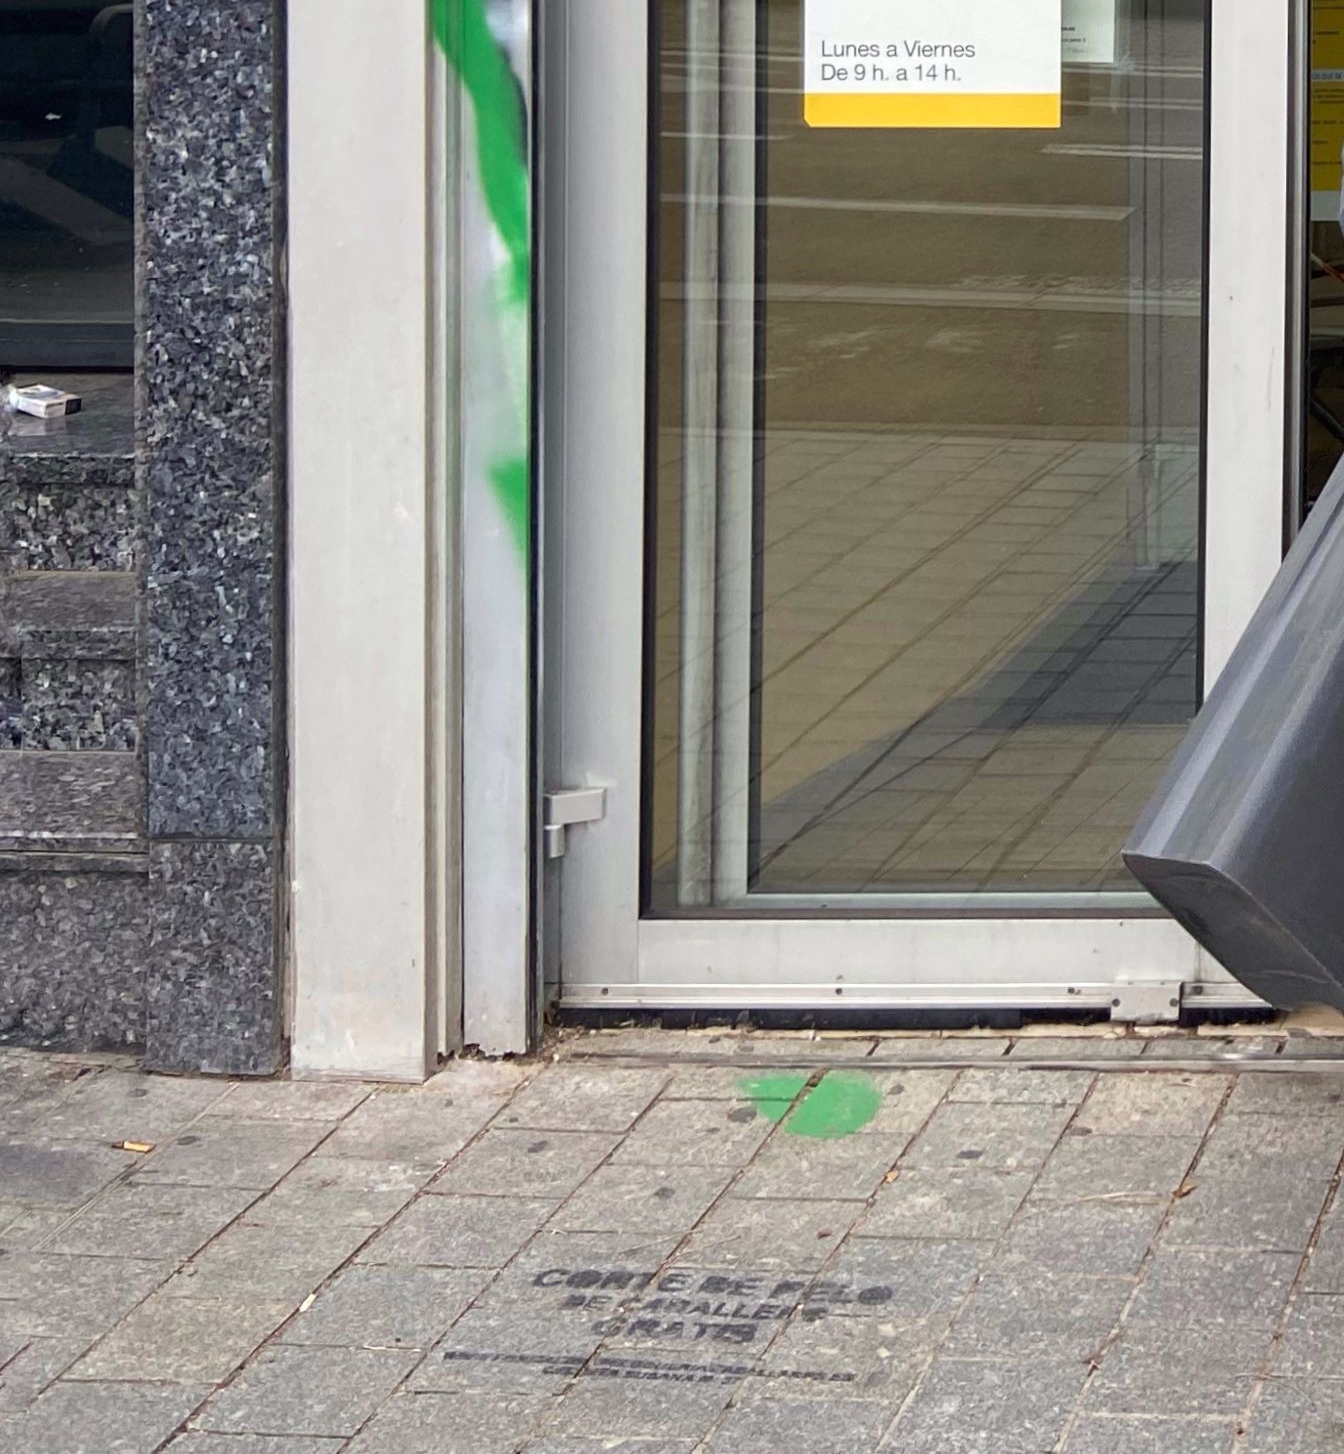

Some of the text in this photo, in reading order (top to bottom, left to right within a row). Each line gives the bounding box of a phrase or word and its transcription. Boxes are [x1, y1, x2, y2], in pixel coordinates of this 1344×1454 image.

[821, 39, 975, 57] Lunes a Viernes
[821, 63, 961, 81] De 9 h. a 14 h.
